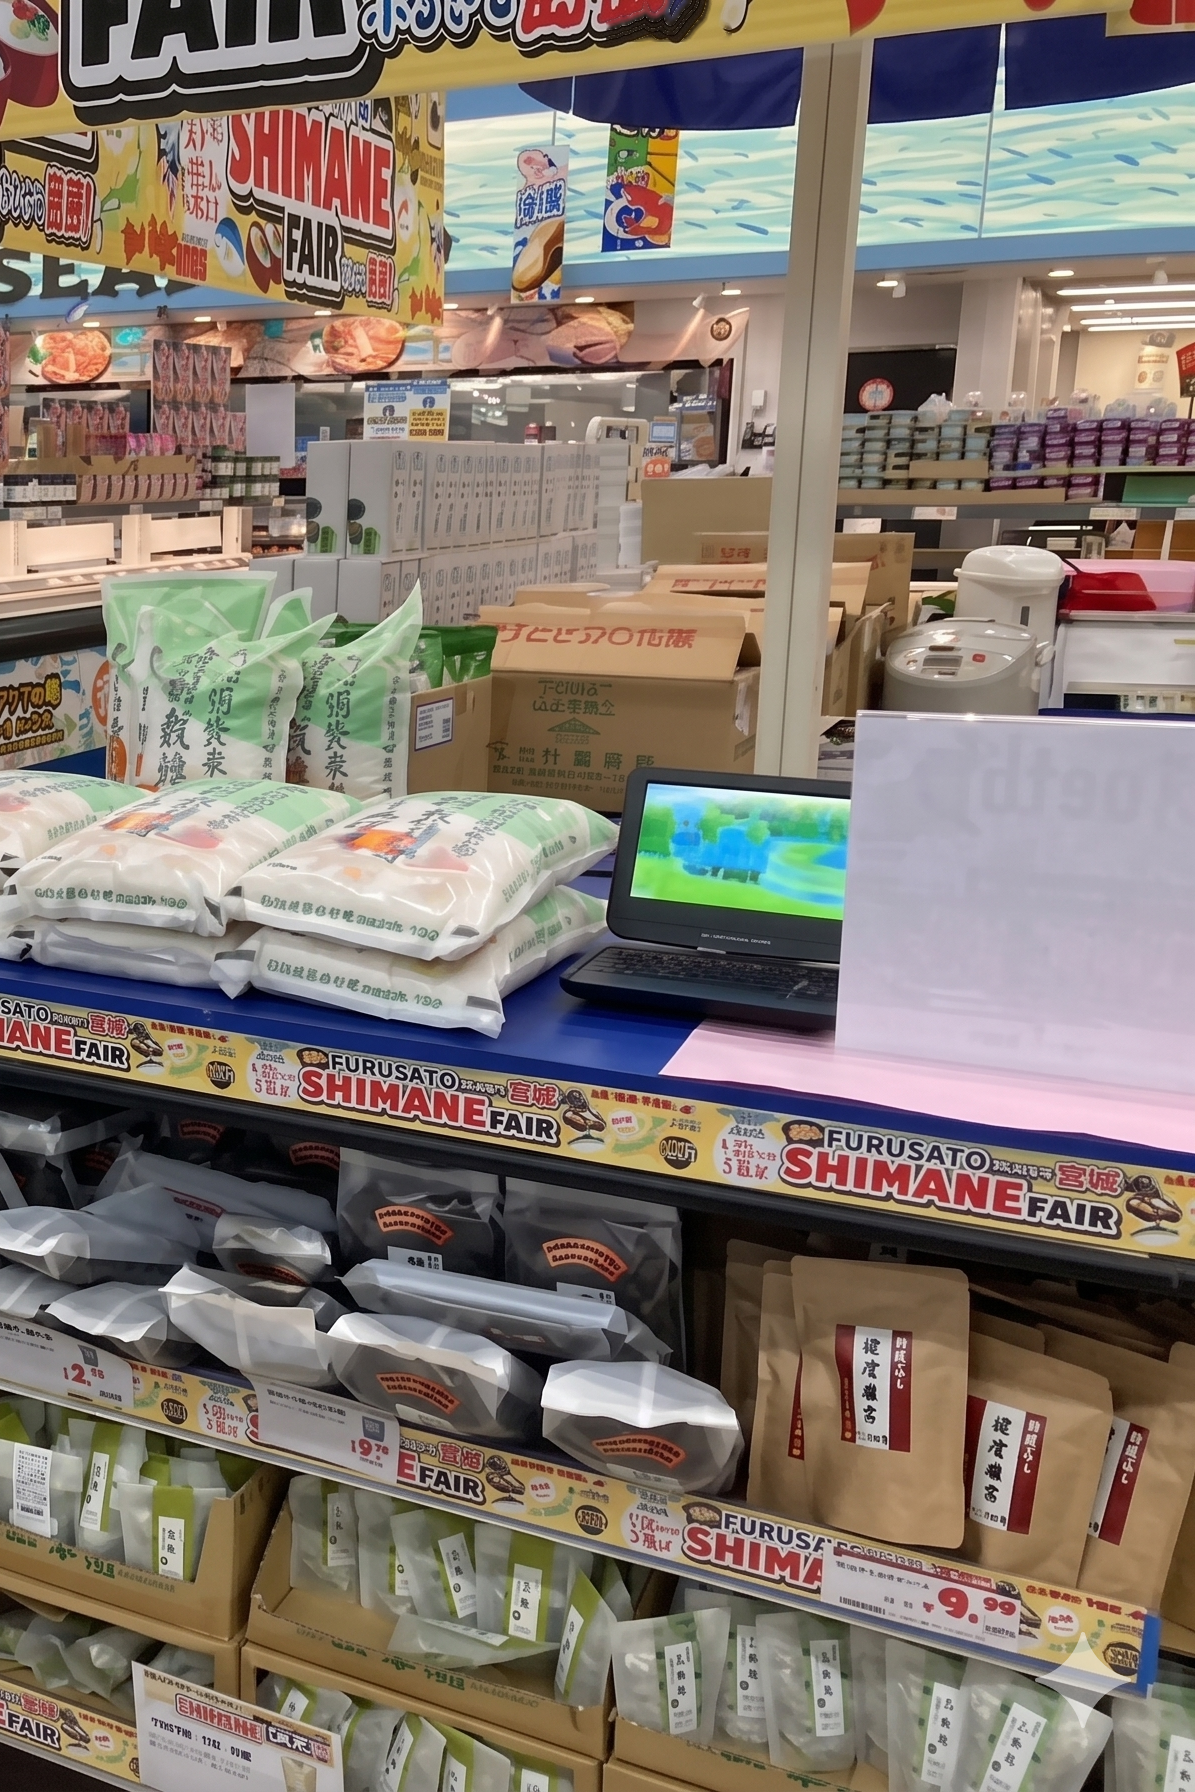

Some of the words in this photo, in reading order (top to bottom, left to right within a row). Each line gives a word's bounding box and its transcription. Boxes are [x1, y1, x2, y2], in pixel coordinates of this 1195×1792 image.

[229, 108, 391, 230] SHIMANE
[286, 214, 339, 283] FAIR
[75, 1041, 128, 1066] FAIR
[331, 1054, 458, 1091] FURUSATO
[301, 1071, 486, 1128] SHIMANE
[490, 1112, 557, 1141] FAIR
[826, 1129, 990, 1171] FURUSATO
[783, 1148, 1025, 1216] SHIMANE
[1027, 1198, 1120, 1232] FAIR
[419, 1469, 485, 1499] FAIR
[7, 1710, 59, 1748] FAIR
